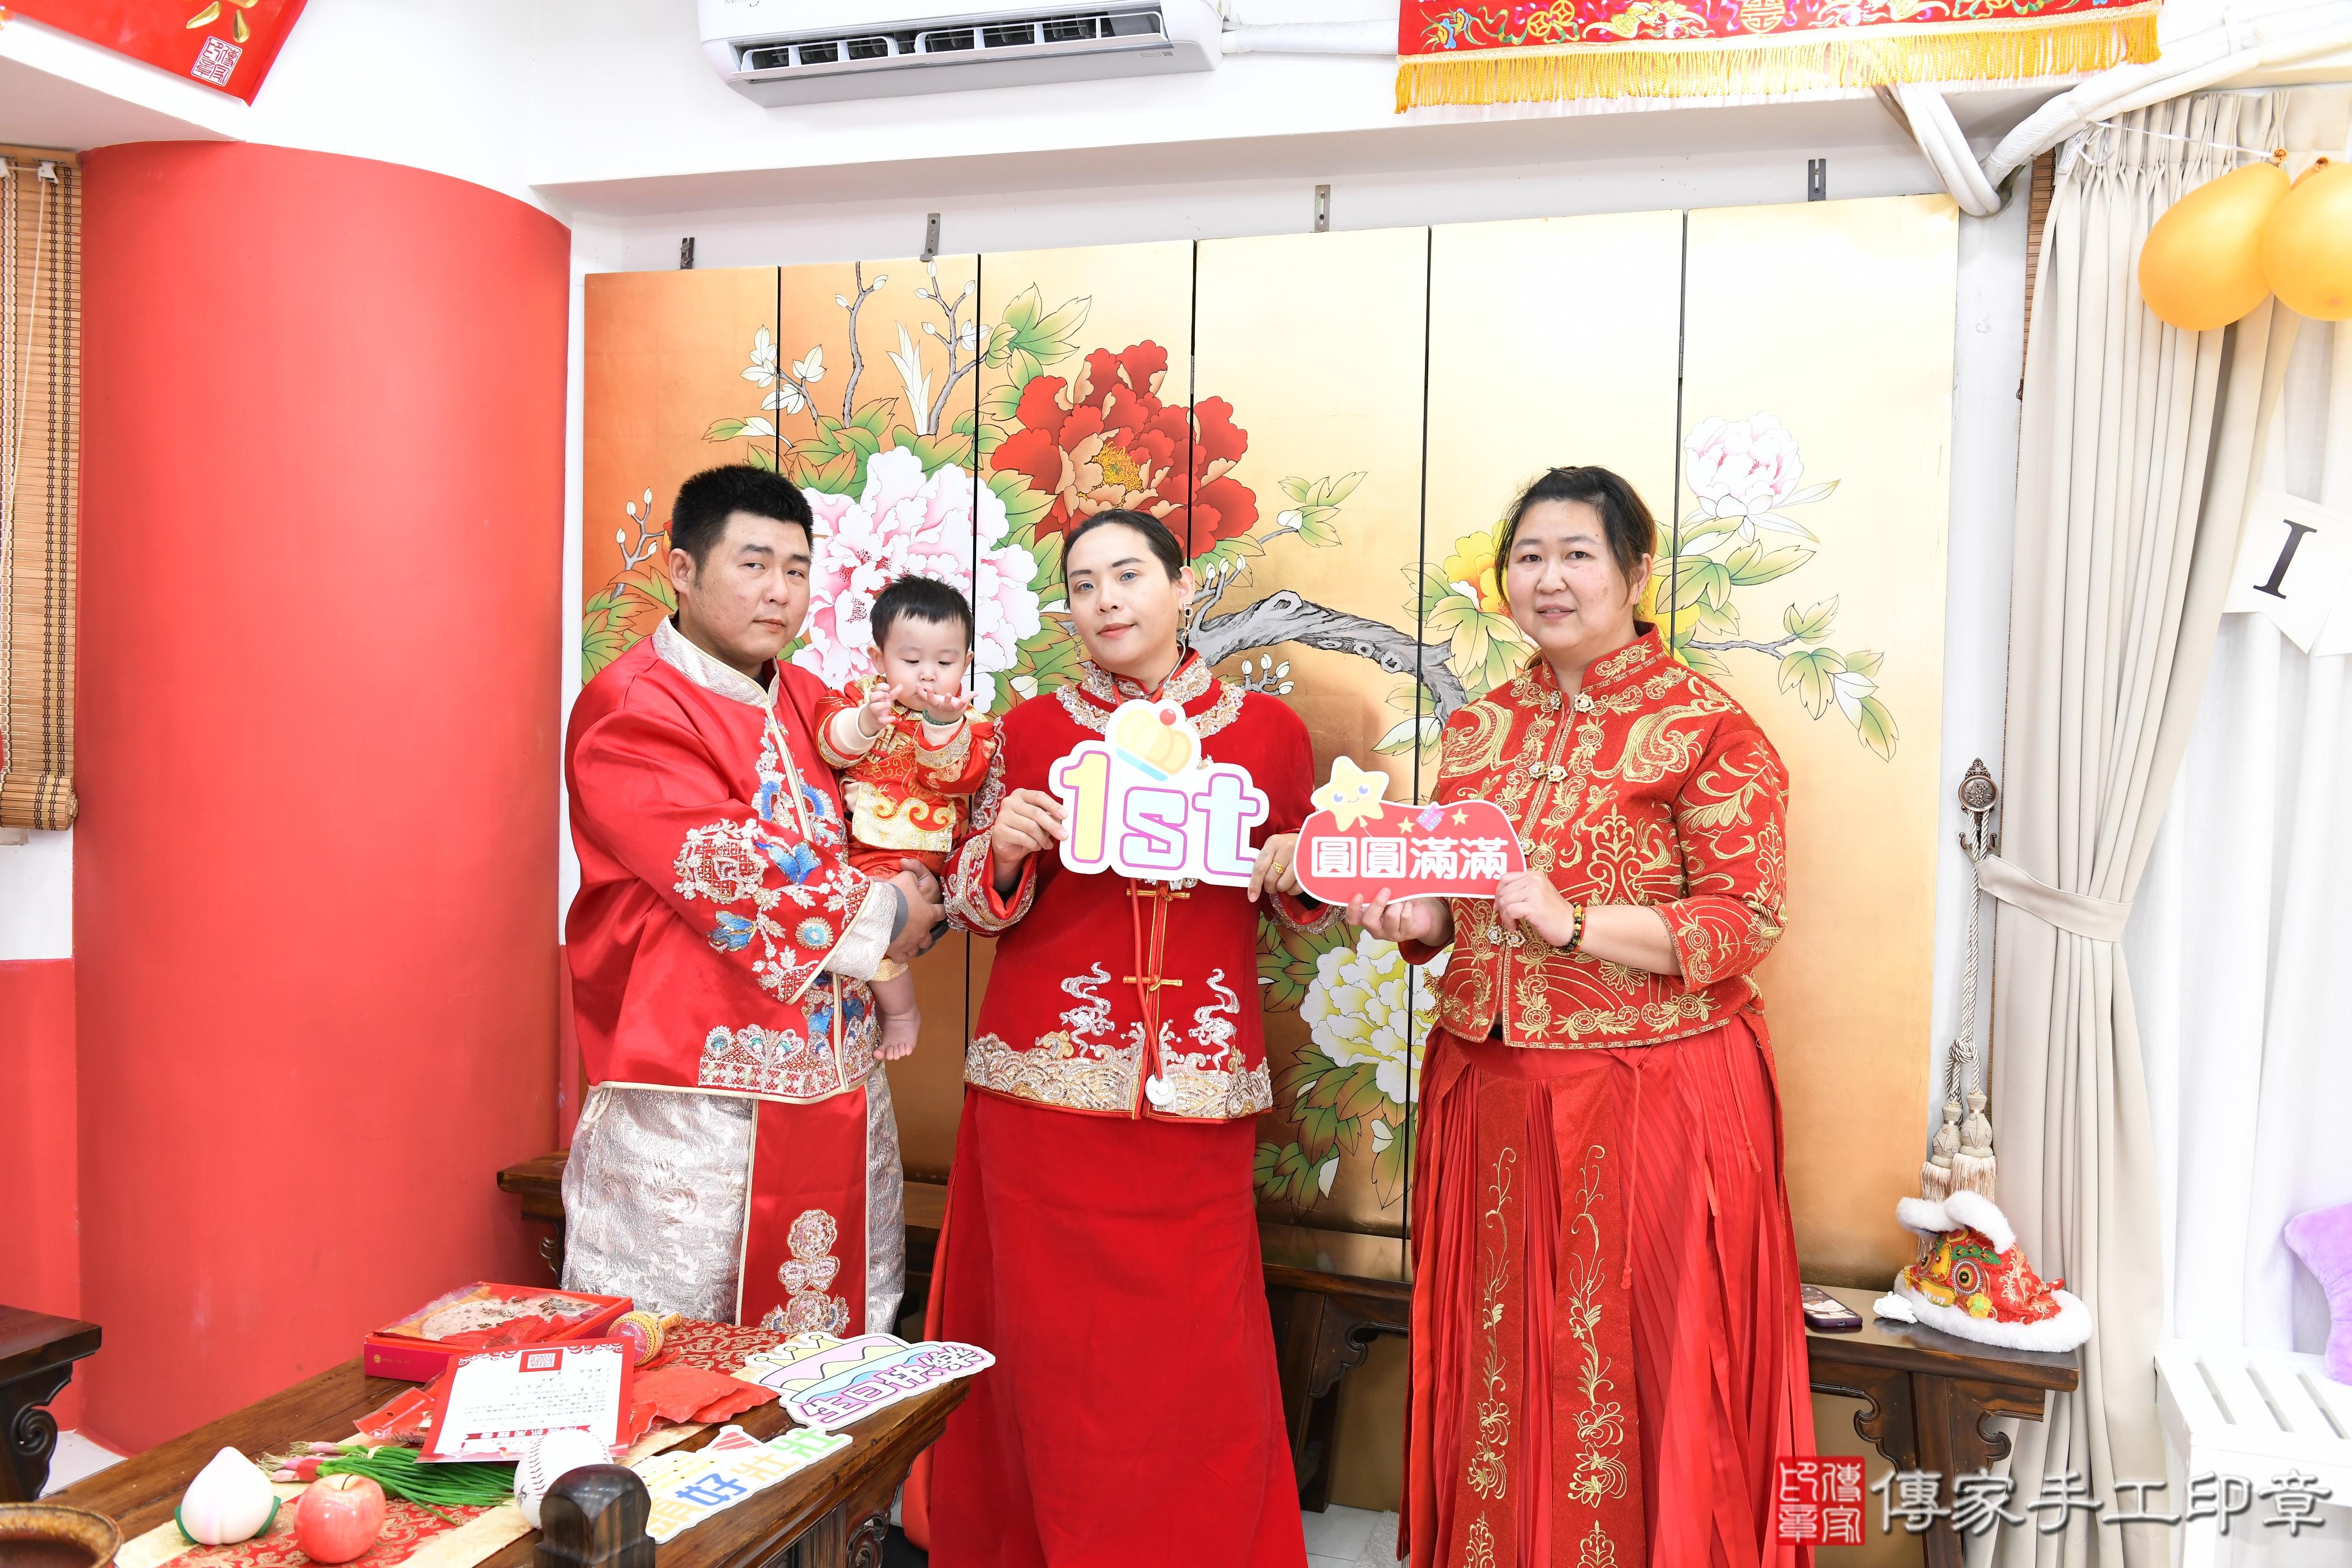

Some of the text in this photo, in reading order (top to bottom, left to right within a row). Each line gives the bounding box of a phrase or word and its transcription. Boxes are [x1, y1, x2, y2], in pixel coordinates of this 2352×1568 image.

[2252, 518, 2317, 599] I
[1060, 750, 1261, 876] 1st
[1311, 836, 1509, 880] 圓圓滿滿
[801, 1346, 985, 1423] 生日快樂
[645, 1428, 846, 1537] 頭好壯壯
